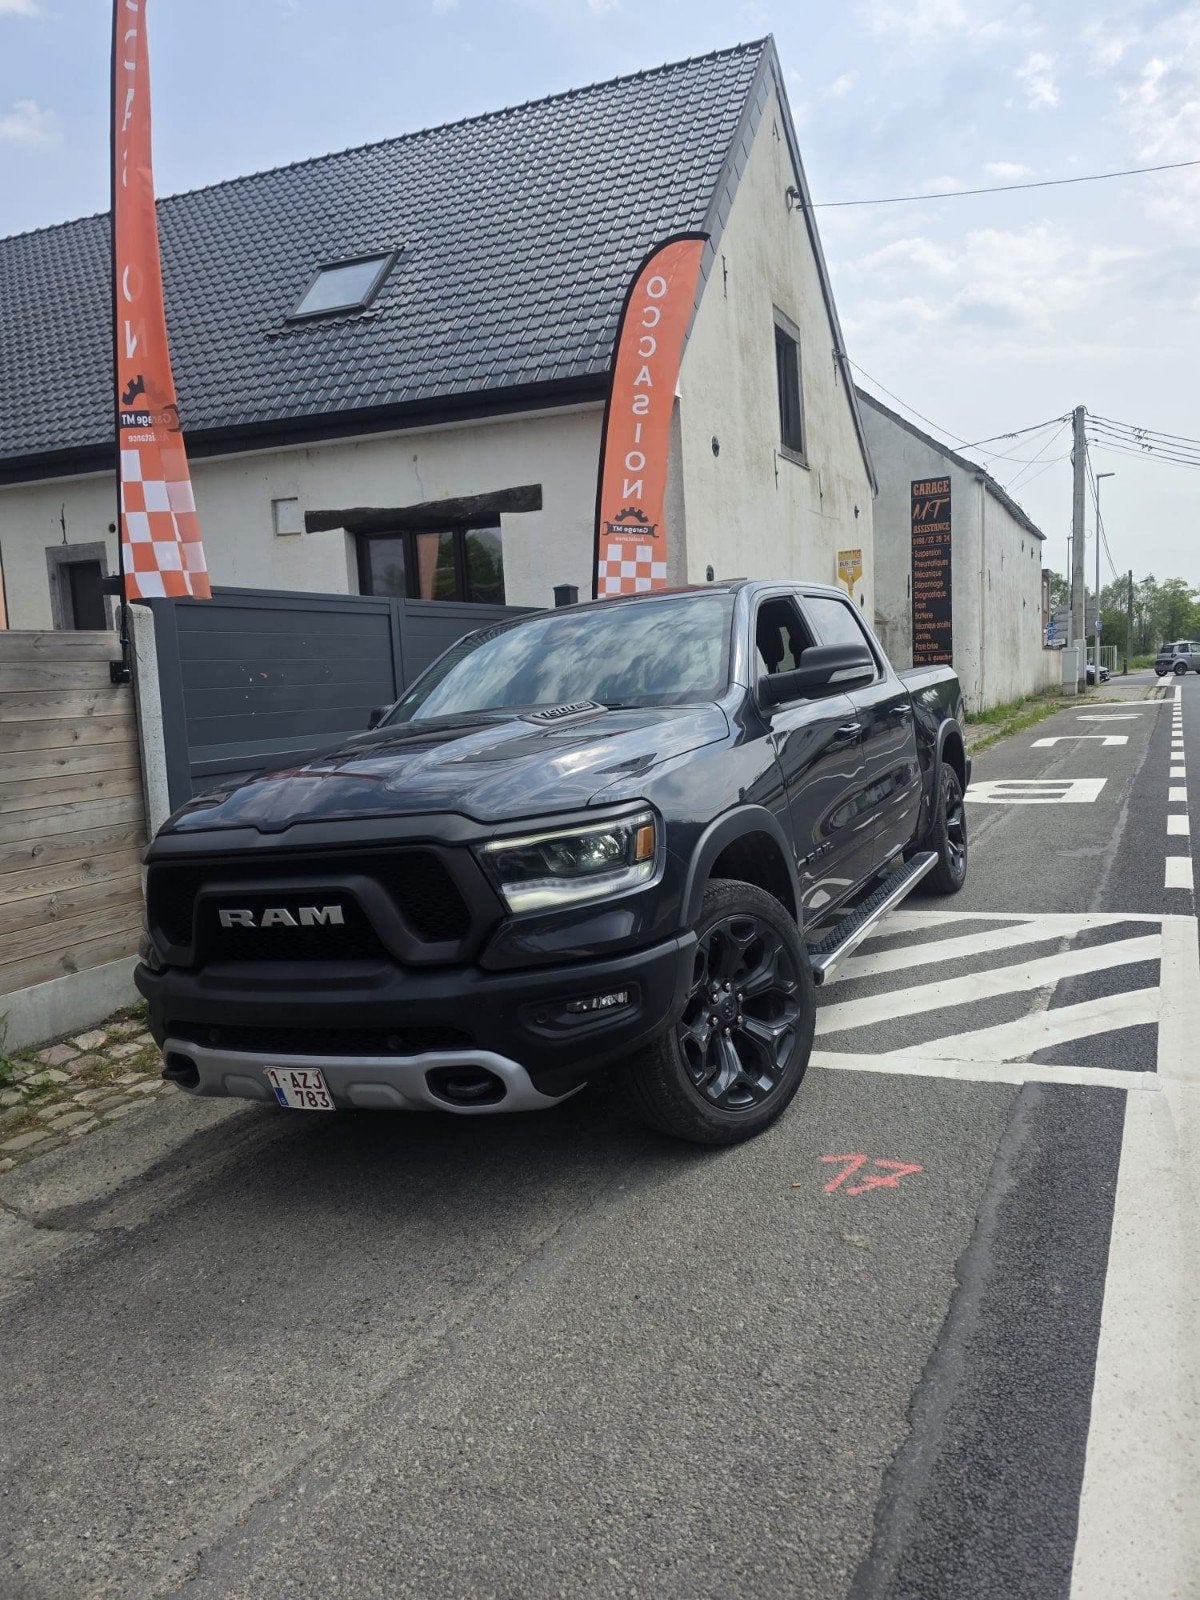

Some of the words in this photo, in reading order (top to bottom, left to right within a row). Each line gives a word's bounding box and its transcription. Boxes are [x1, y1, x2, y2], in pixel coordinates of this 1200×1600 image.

[913, 480, 949, 496] GARAGE
[912, 498, 950, 520] MT
[913, 522, 950, 534] ASSISTANCE
[219, 905, 345, 927] RAM
[294, 1090, 330, 1108] 783
